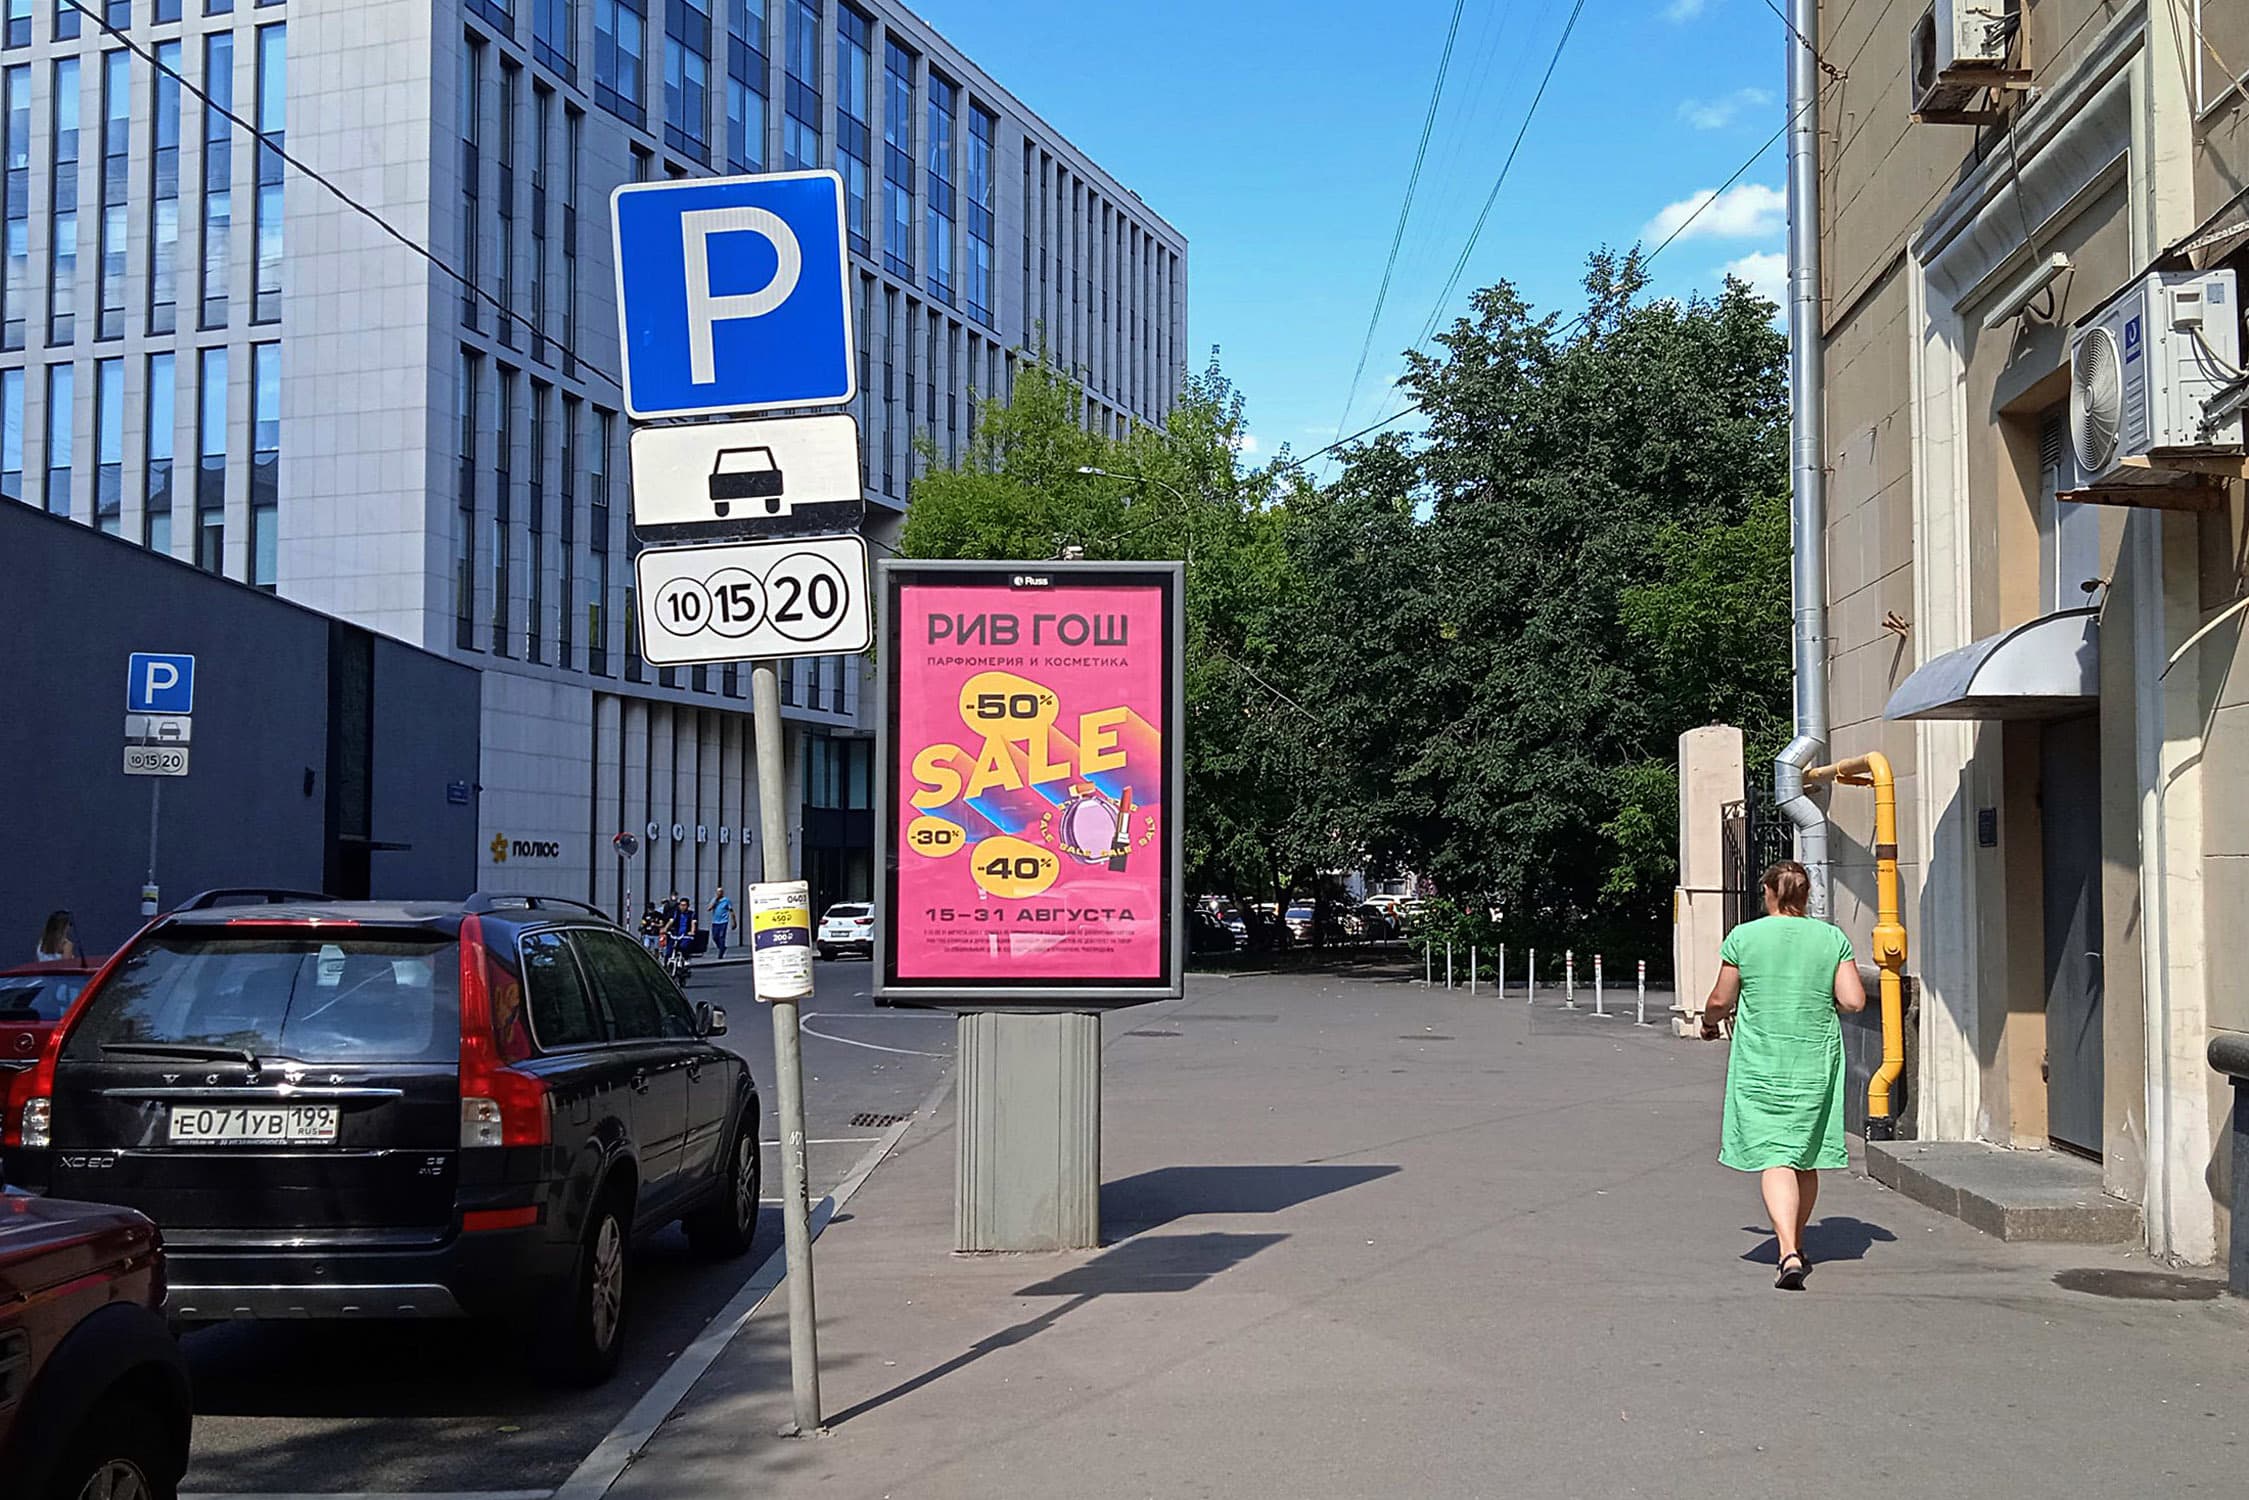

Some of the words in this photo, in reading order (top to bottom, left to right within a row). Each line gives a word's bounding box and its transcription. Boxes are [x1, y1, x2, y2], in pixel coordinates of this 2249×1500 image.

[681, 205, 802, 385] P
[1025, 576, 1049, 586] Russ
[667, 591, 701, 623] 10
[714, 583, 755, 623] 15
[774, 573, 838, 623] 20
[928, 614, 1020, 646] РИВ
[1033, 614, 1128, 646] ГОШ
[927, 657, 1024, 667] ПАРФЮМЕРИЯ
[1030, 657, 1039, 667] И
[1044, 657, 1129, 667] КОСМЕТИКА
[145, 662, 179, 704] P
[966, 694, 1053, 719] -50%
[131, 755, 142, 765] 10
[145, 755, 158, 766] 15
[162, 755, 181, 767] 20
[909, 706, 1128, 809] SALE
[910, 829, 960, 845] -30%
[512, 840, 560, 858] ПОЛЮС
[977, 857, 1052, 879] -40%
[1016, 909, 1136, 922] АВГУСТА
[291, 1107, 330, 1128] 199
[297, 1127, 318, 1136] RUS
